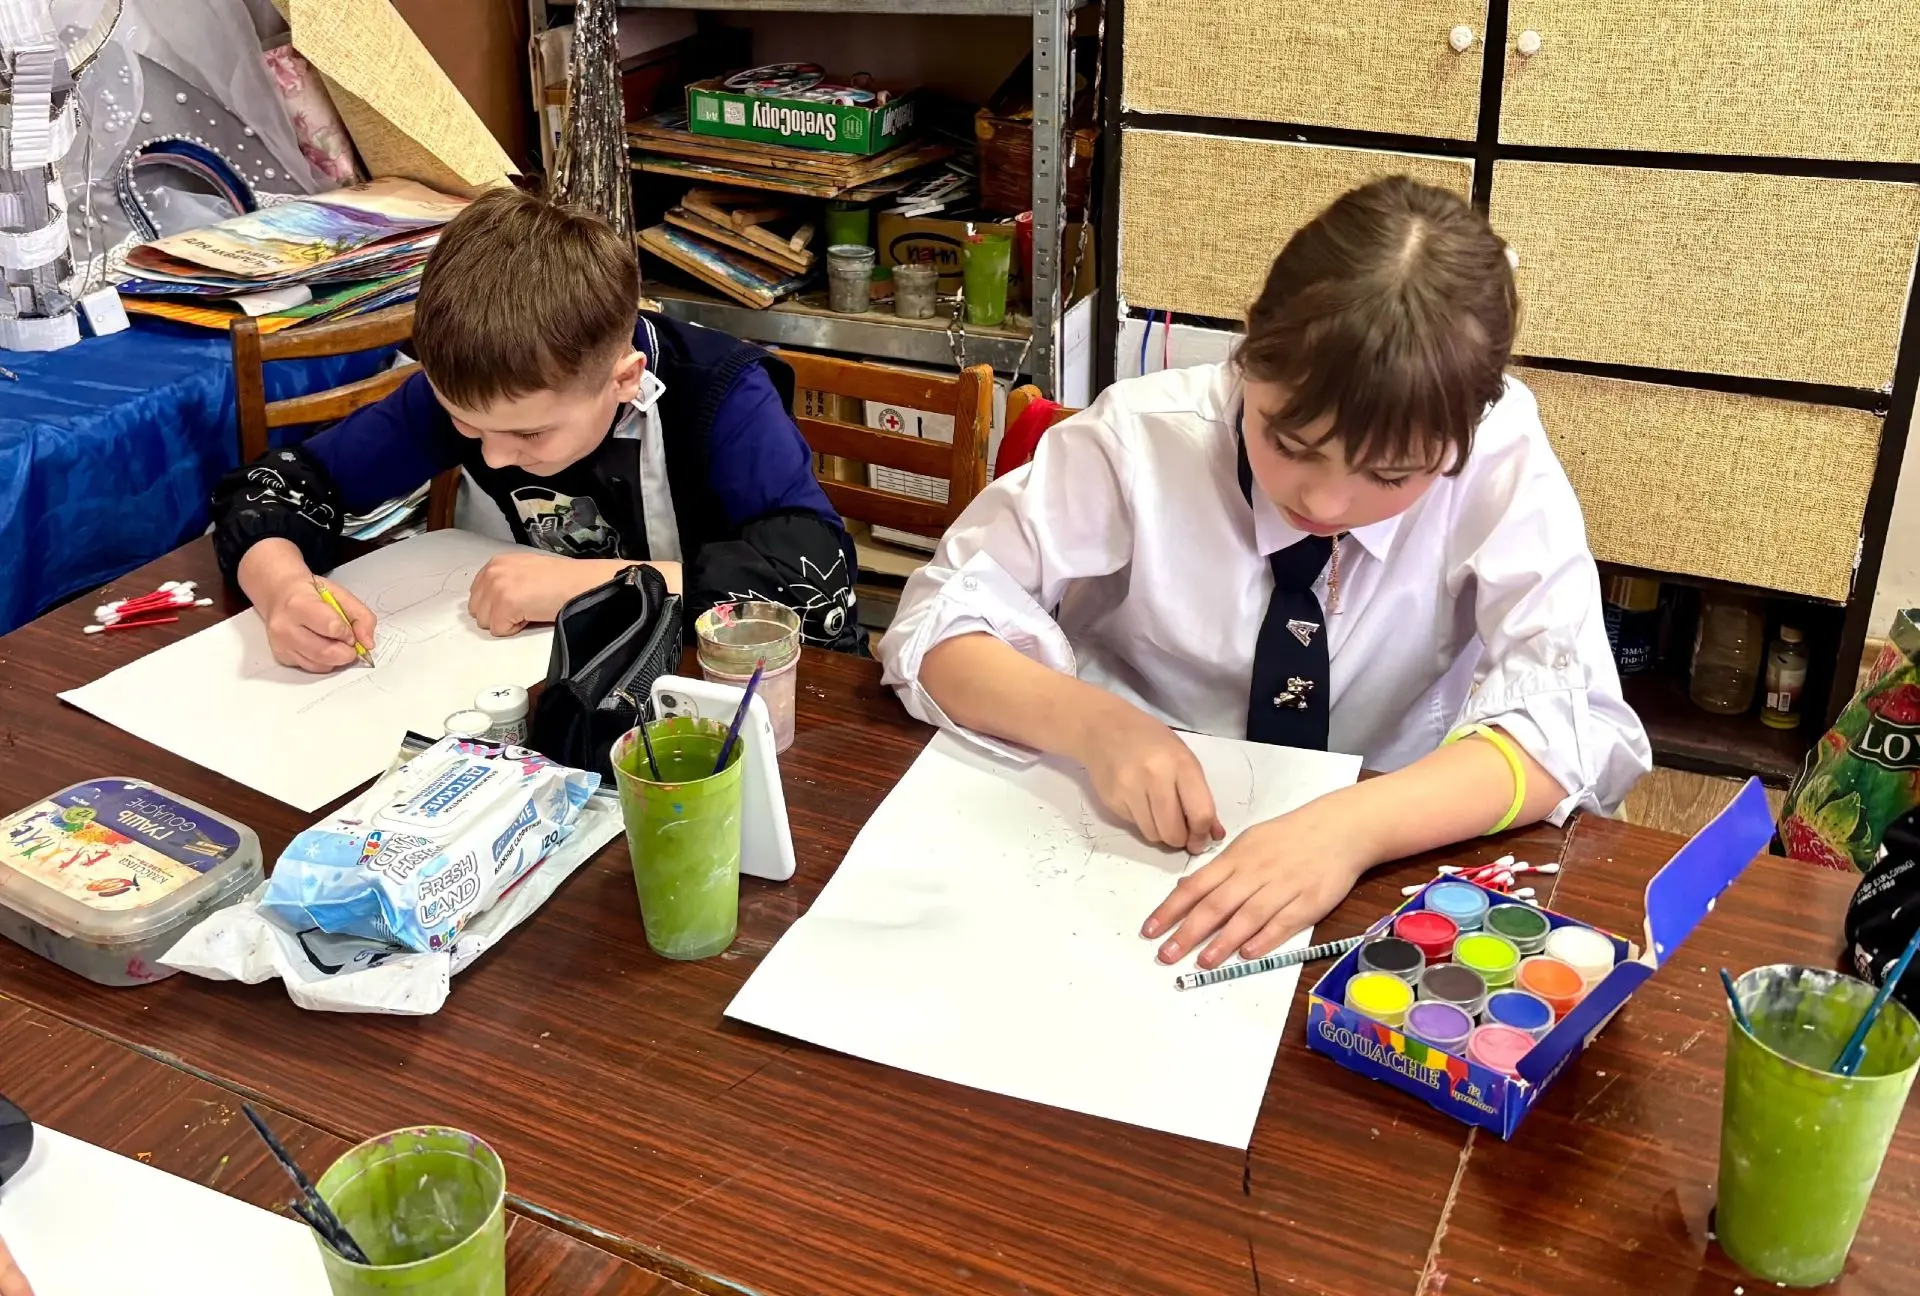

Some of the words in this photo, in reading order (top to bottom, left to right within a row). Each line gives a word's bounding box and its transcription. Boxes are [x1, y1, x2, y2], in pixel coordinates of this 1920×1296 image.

[753, 101, 836, 142] SvetoCopy
[427, 766, 485, 810] ДЕТСКИЕ
[118, 810, 175, 842] ГУАШЬ
[125, 797, 197, 833] GOUACHE
[541, 829, 559, 850] 120
[418, 857, 474, 900] FRESH
[420, 878, 477, 924] LAND
[1318, 1019, 1441, 1090] GOUACHE
